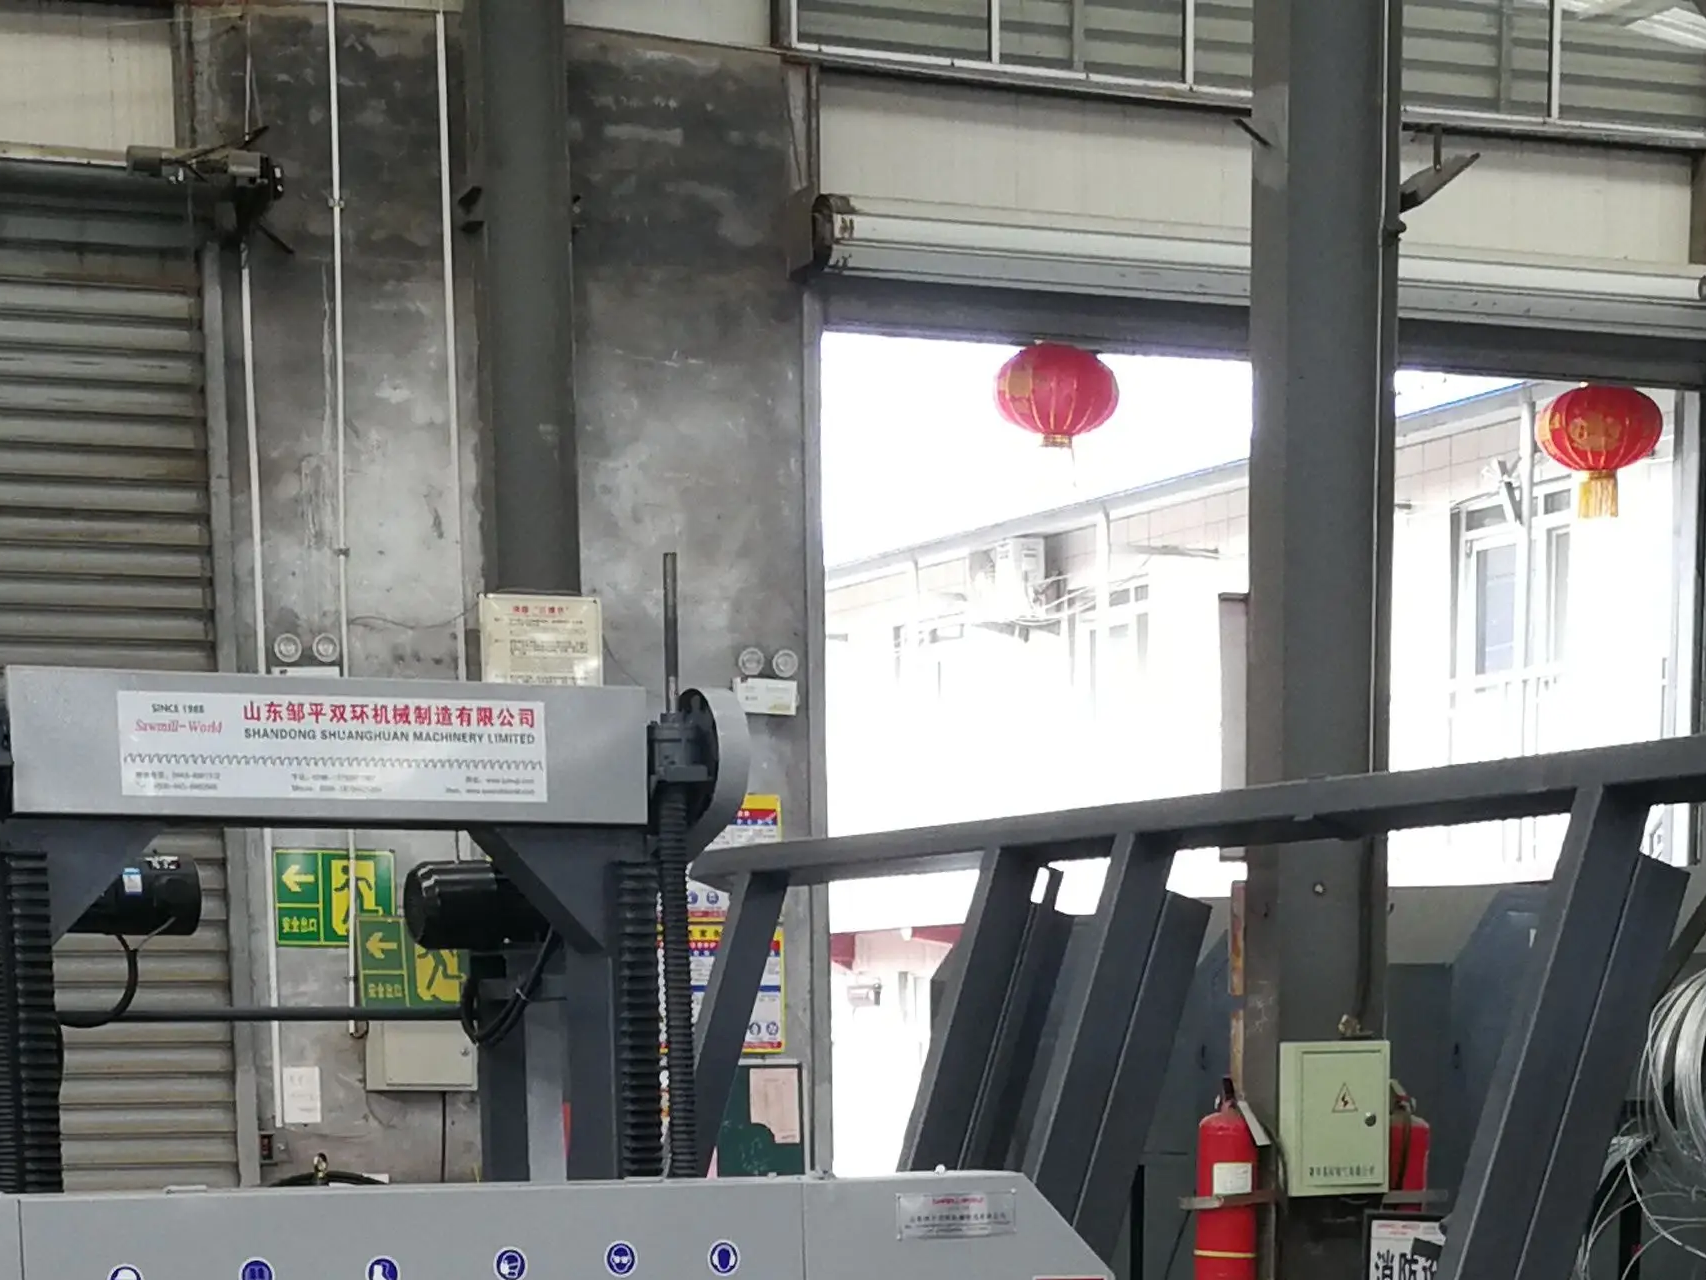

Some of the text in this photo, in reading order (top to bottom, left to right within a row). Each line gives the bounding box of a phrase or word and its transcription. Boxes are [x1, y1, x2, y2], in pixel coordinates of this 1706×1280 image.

[151, 703, 179, 713] SINCE
[243, 701, 535, 729] 山东邹平双环机械制造有限公司
[244, 728, 535, 744] SHANDONG SHUANGHUAN MACHINERY LIMITED
